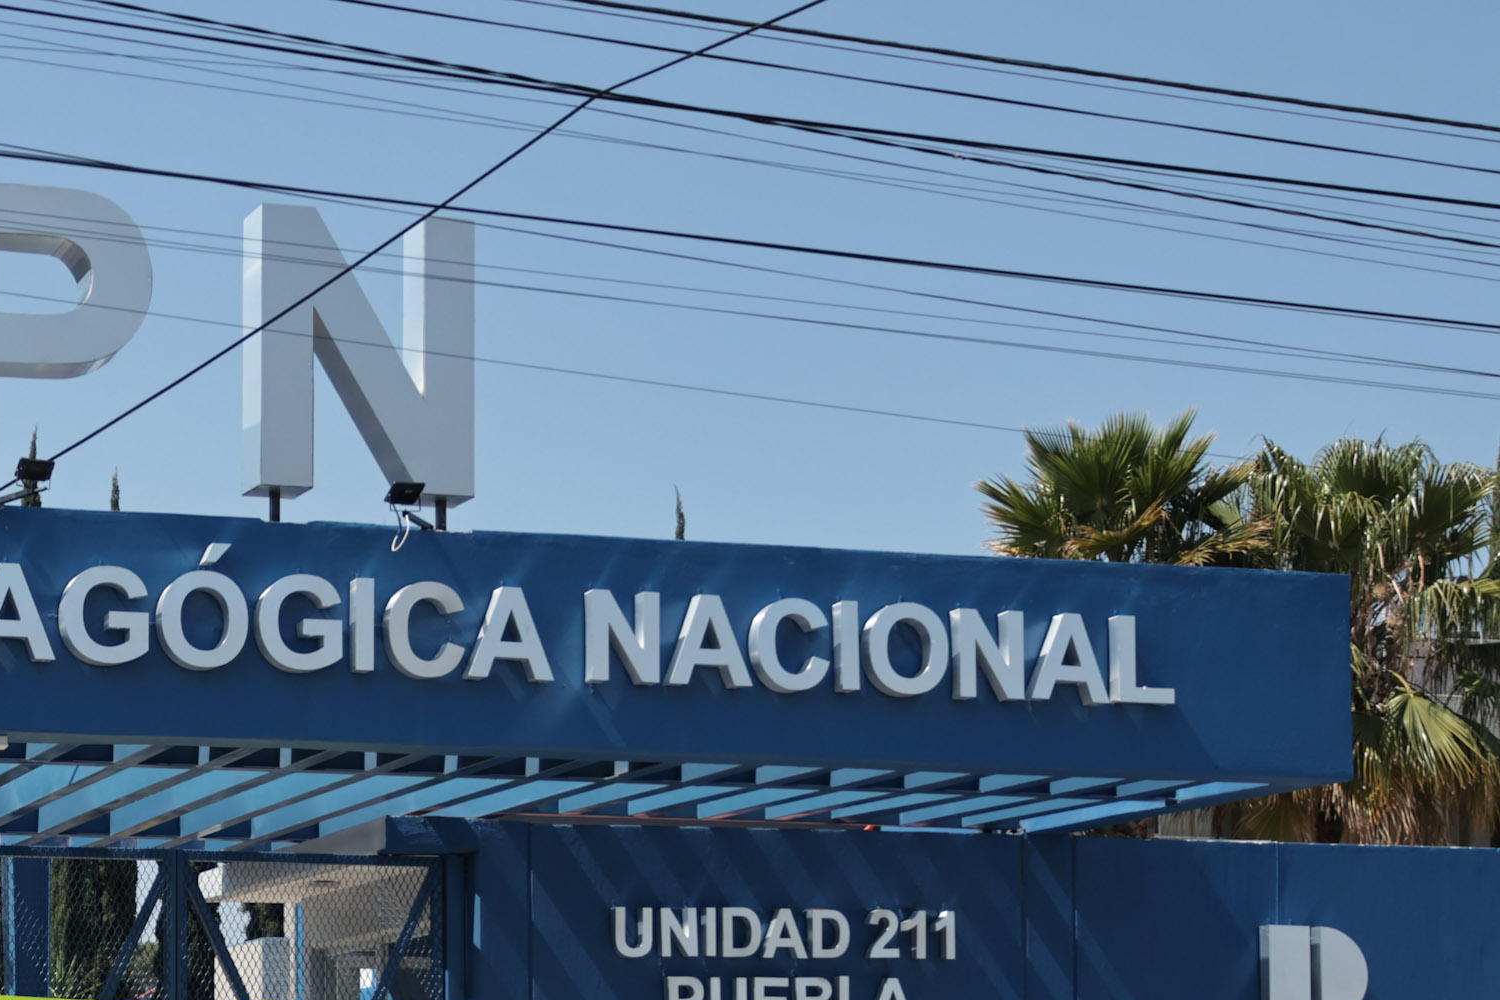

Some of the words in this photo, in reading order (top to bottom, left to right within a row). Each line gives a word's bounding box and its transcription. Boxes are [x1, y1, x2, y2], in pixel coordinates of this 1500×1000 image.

[583, 588, 1175, 705] NACIONAL
[613, 906, 850, 960] UNIDAD
[869, 908, 957, 960] 211
